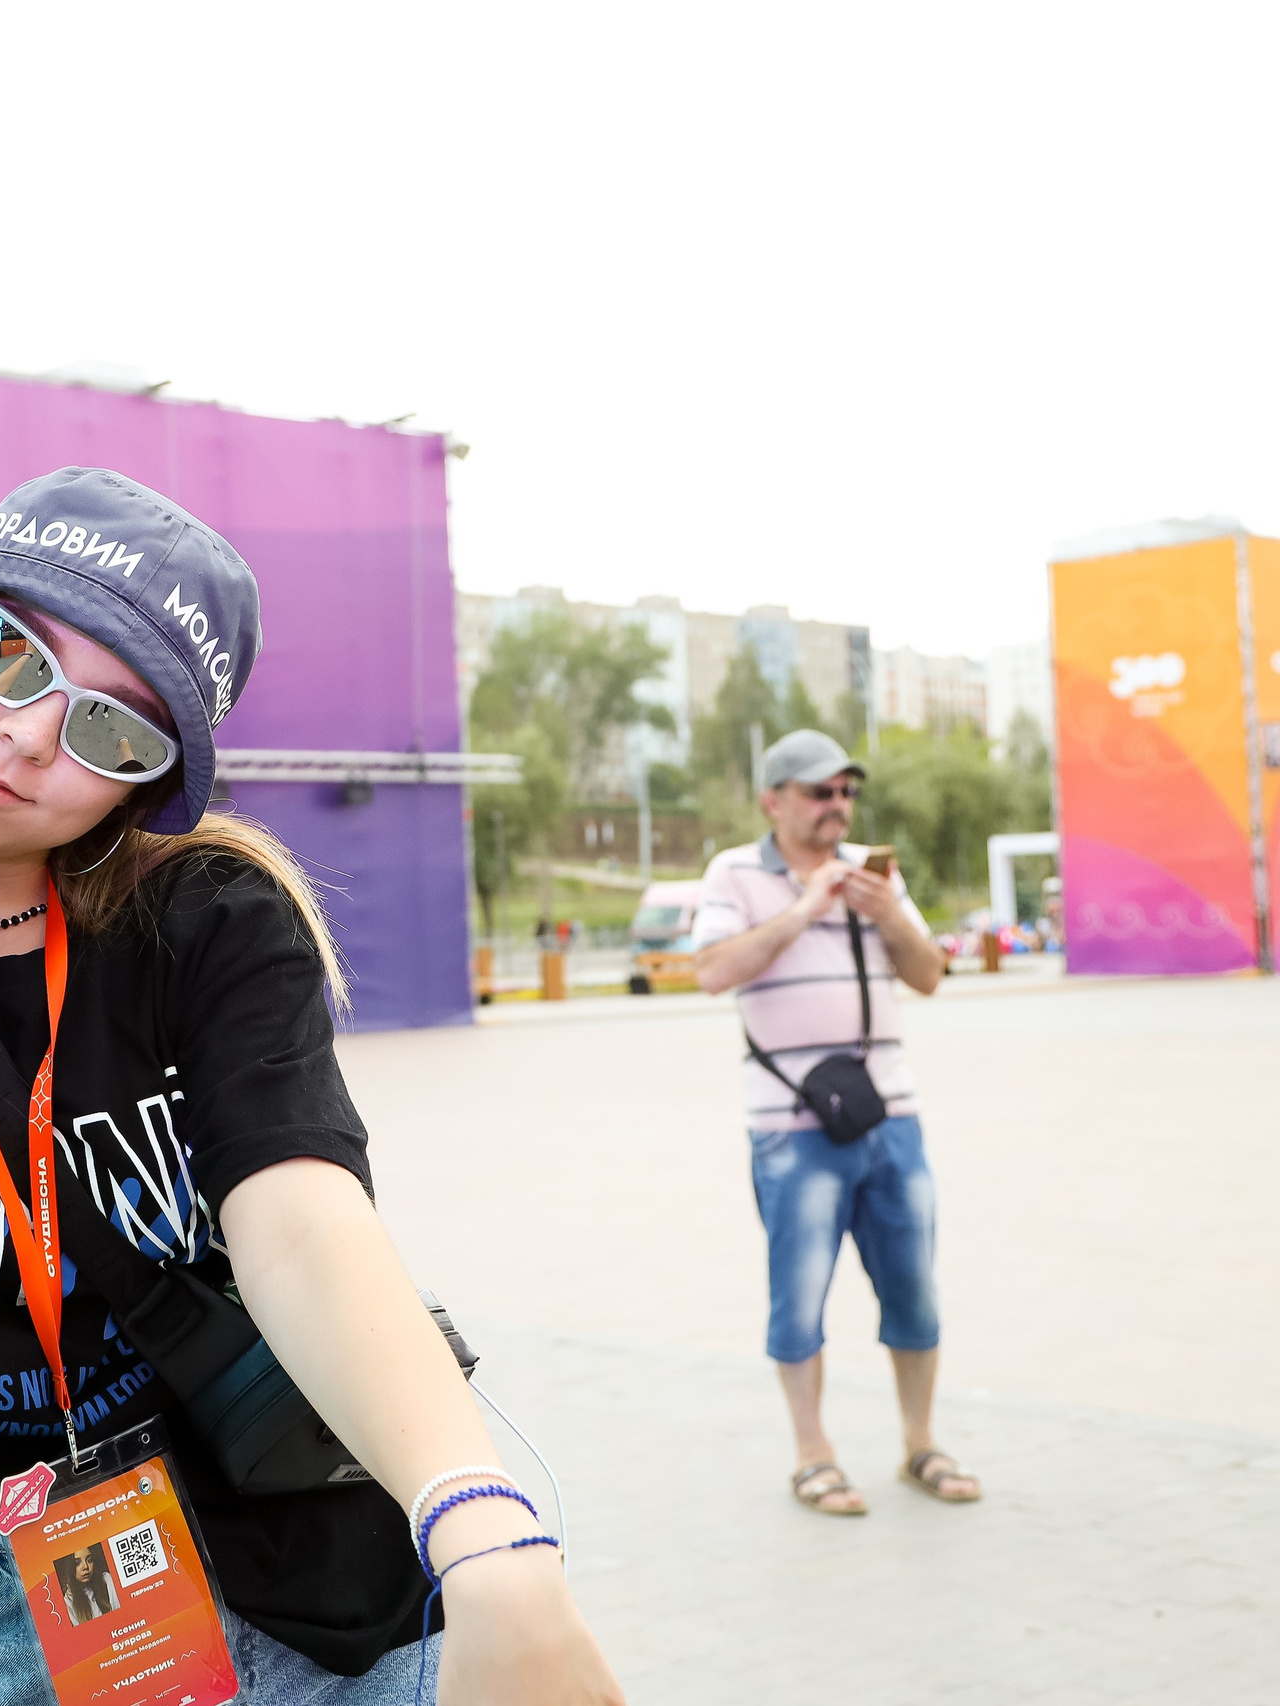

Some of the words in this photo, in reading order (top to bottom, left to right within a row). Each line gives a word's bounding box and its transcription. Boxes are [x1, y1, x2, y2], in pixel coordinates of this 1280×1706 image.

[37, 1156, 56, 1278] СТУДВЕСНА
[42, 1489, 138, 1534] СТУДВЕСНА
[110, 1618, 147, 1639] Ксения
[112, 1629, 153, 1652] Буярова
[99, 1649, 138, 1669] Республика
[138, 1634, 171, 1652] Мордовия
[112, 1657, 176, 1691] УЧАСТНИК
